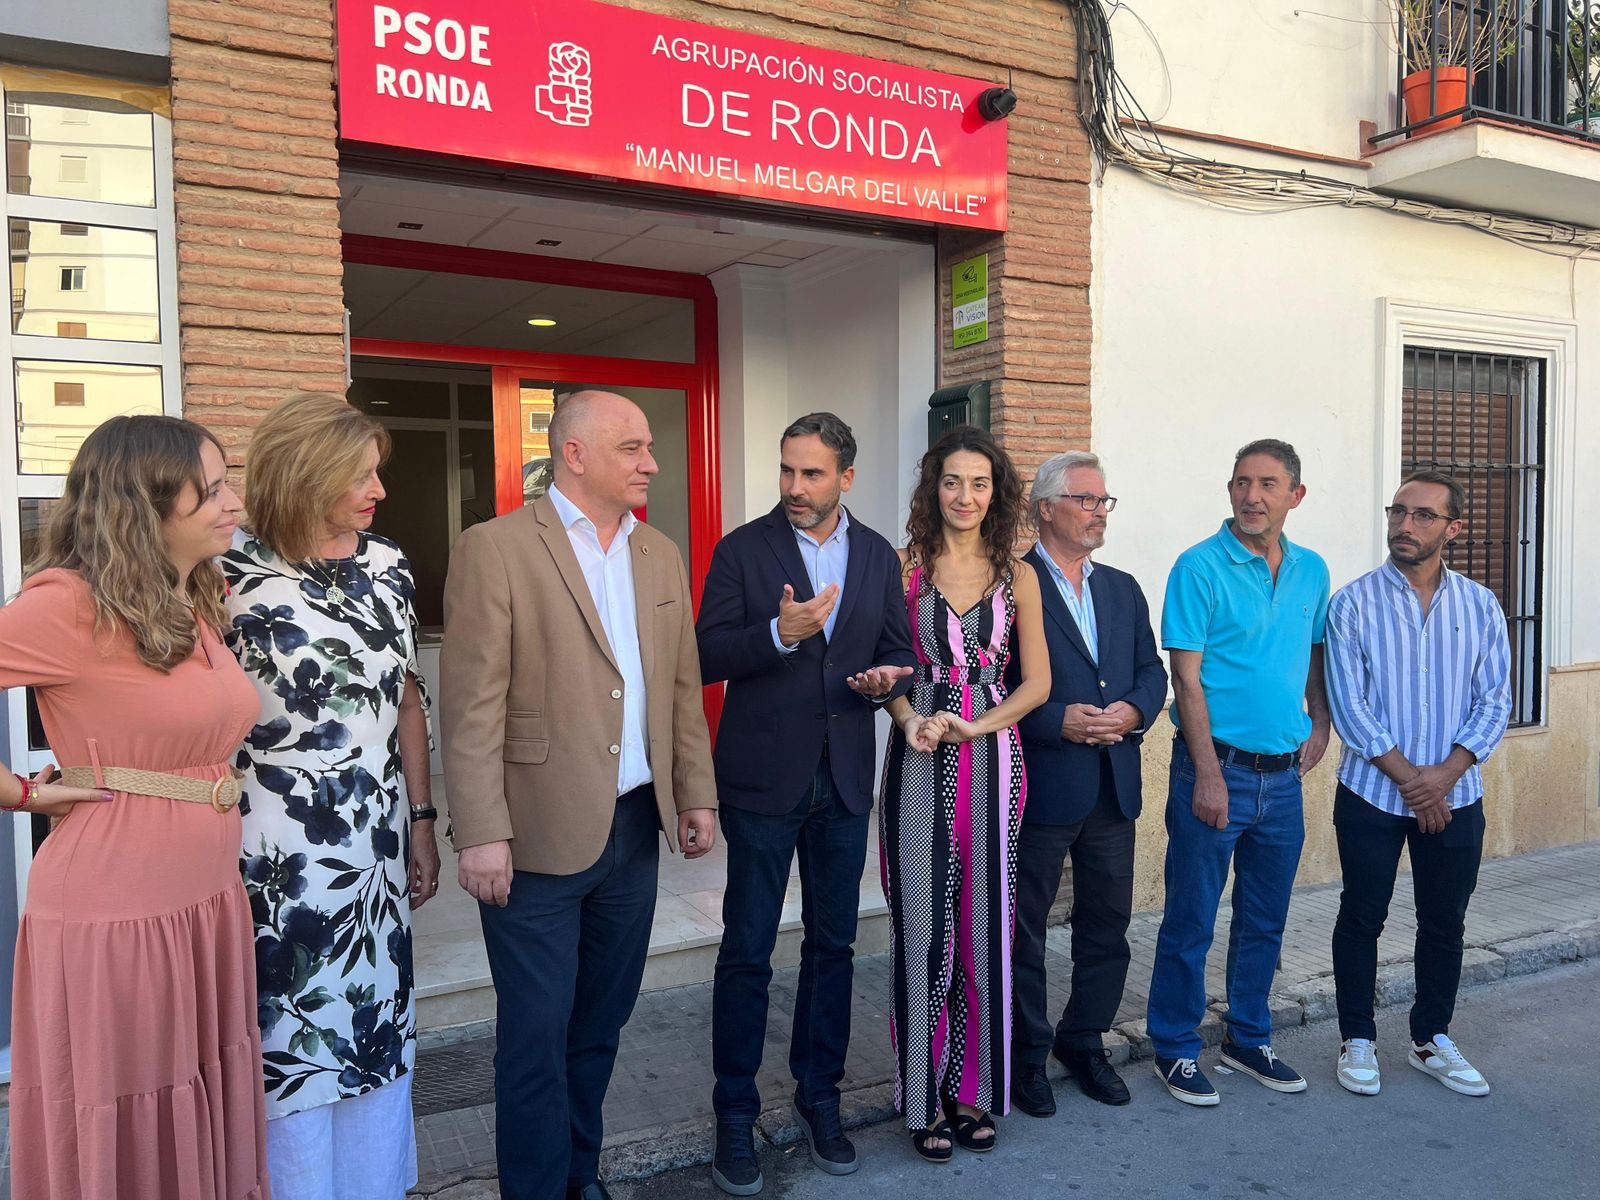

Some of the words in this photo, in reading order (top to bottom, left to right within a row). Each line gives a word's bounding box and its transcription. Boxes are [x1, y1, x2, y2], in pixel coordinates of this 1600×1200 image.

[373, 4, 493, 67] PSOE
[375, 63, 494, 113] RONDA
[651, 34, 825, 88] AGRUPACIÓN
[832, 68, 966, 114] SOCIALISTA
[681, 83, 753, 138] DE
[771, 99, 943, 169] RONDA
[752, 162, 859, 199] MELGAR
[863, 178, 909, 206] DEL
[966, 310, 986, 322] VISION
